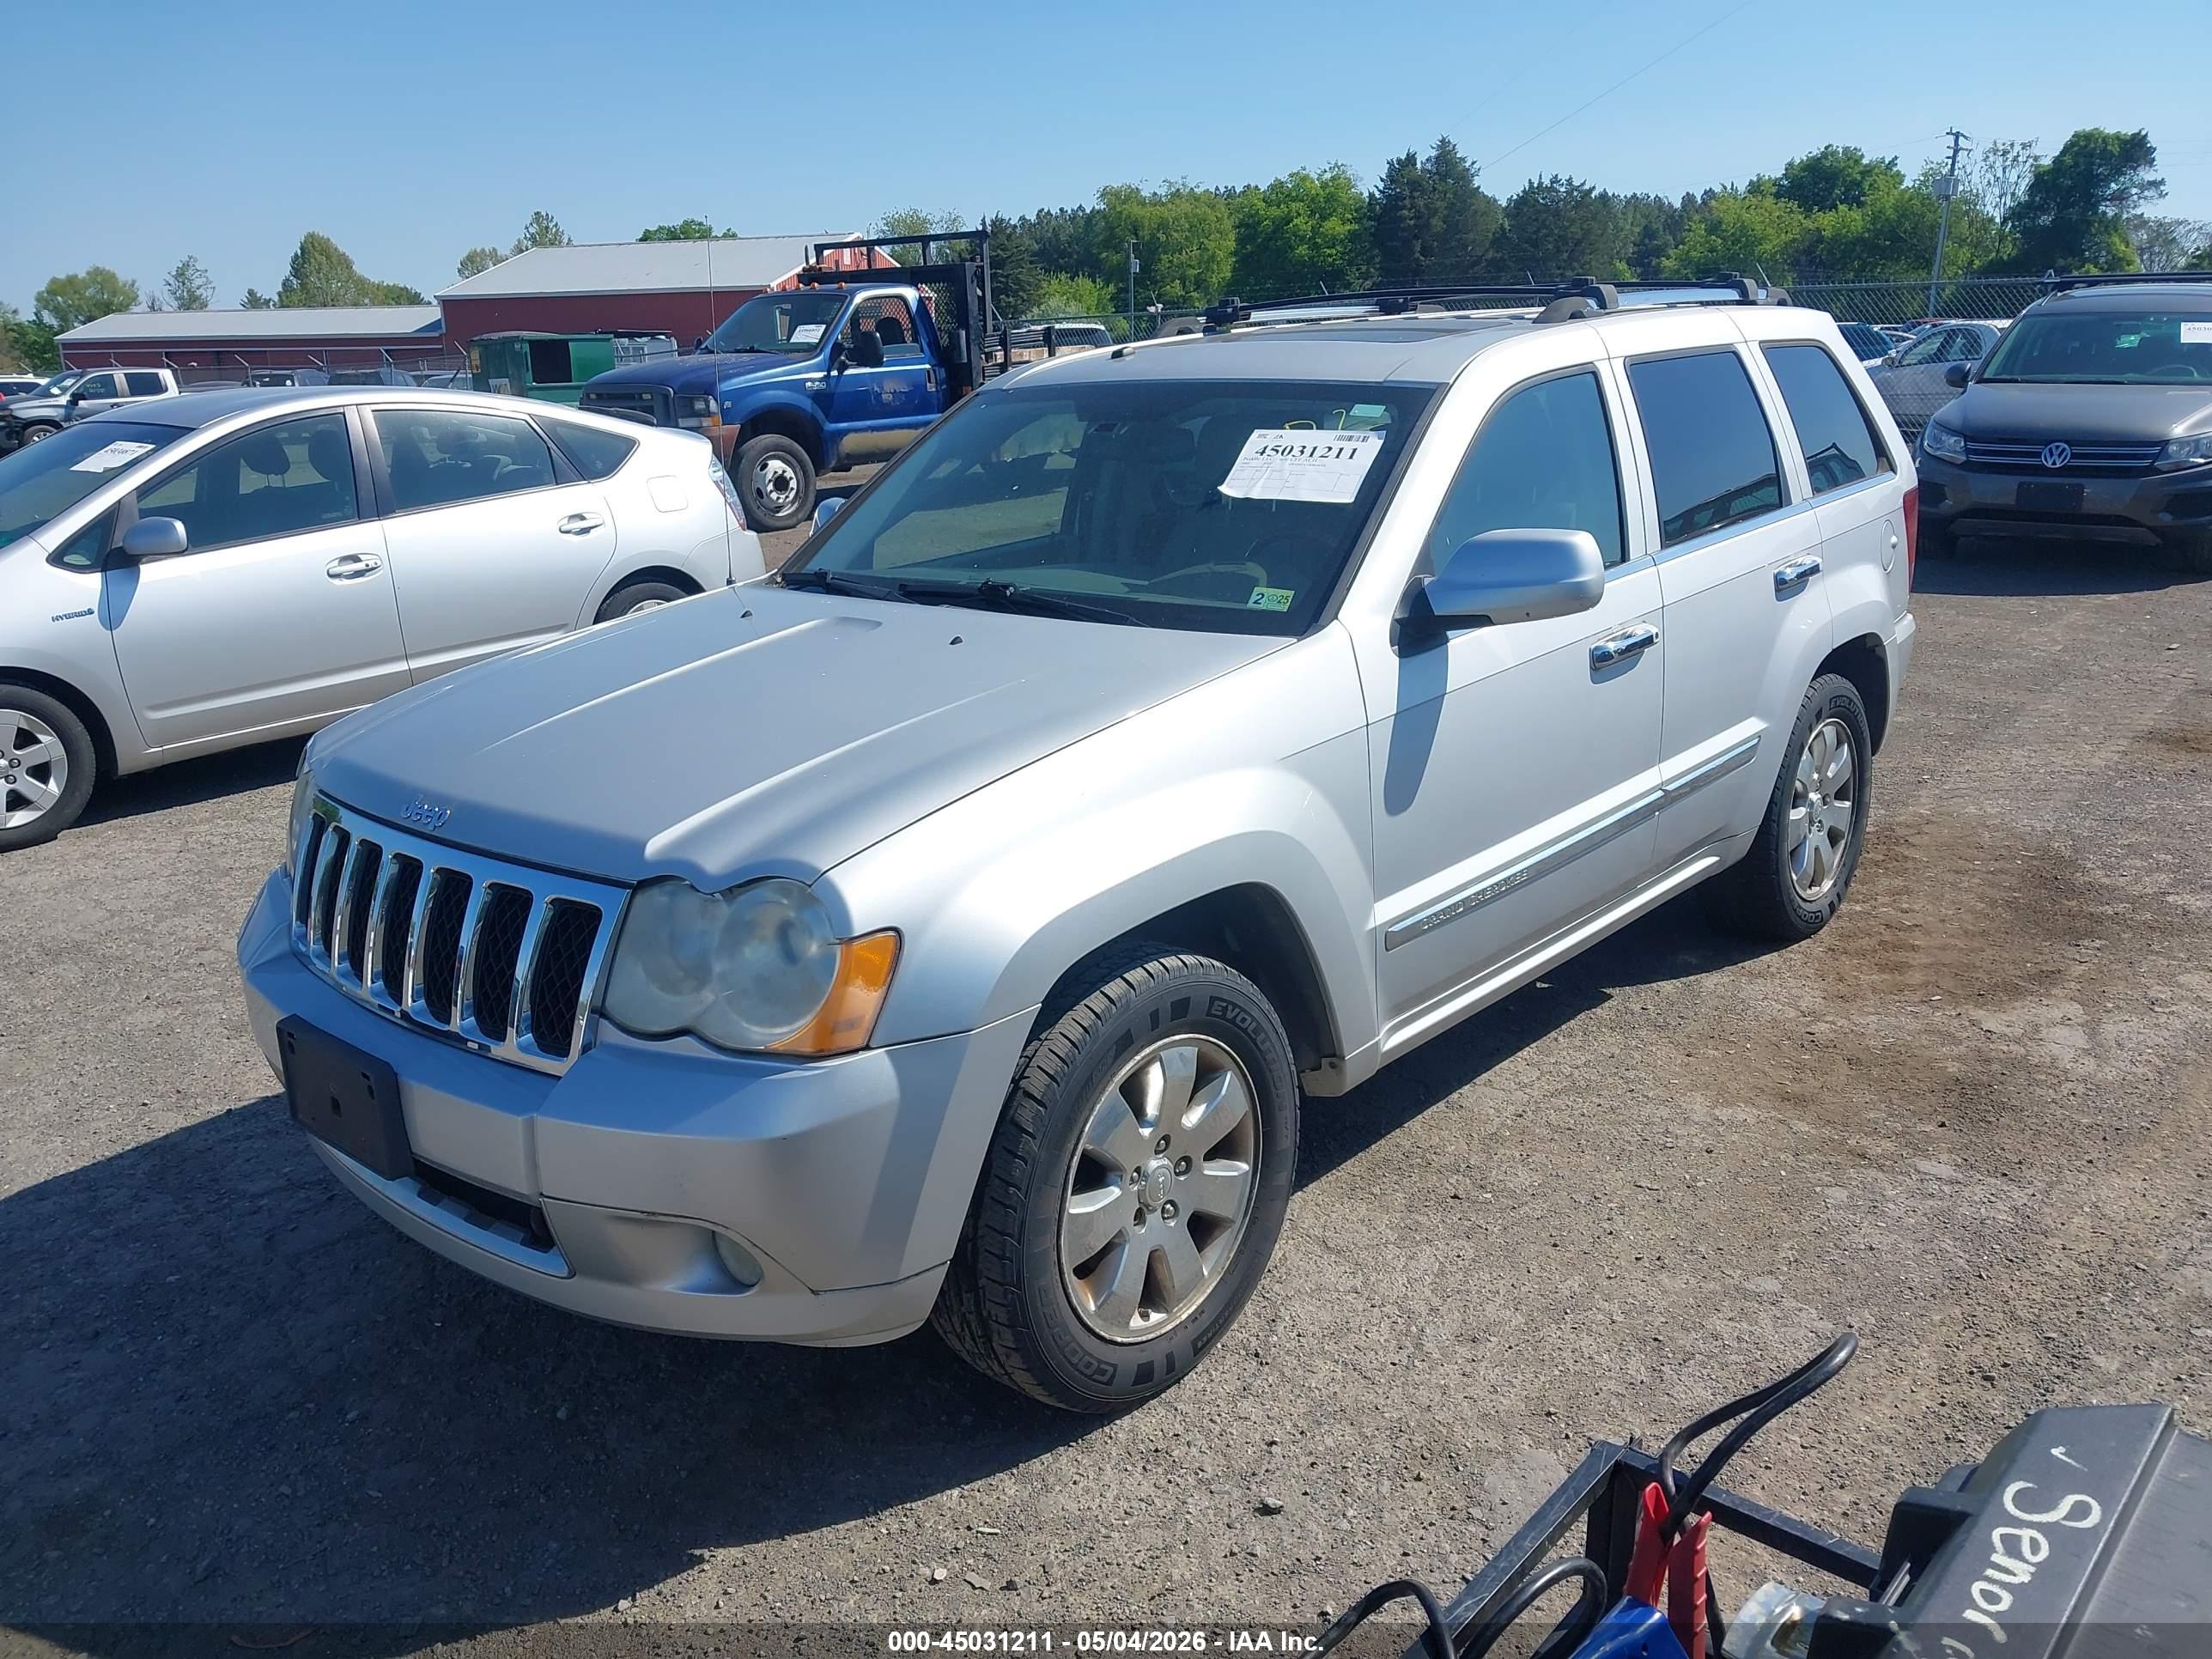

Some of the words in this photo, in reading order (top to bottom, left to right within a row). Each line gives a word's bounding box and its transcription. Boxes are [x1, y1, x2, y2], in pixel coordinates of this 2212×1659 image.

[1255, 445, 1358, 460] 45031211
[1252, 592, 1265, 605] 2
[1277, 594, 1291, 605] 25
[399, 794, 452, 830] Jeep
[1421, 901, 1464, 930] GRAND
[1469, 868, 1528, 906] CHEROKEE
